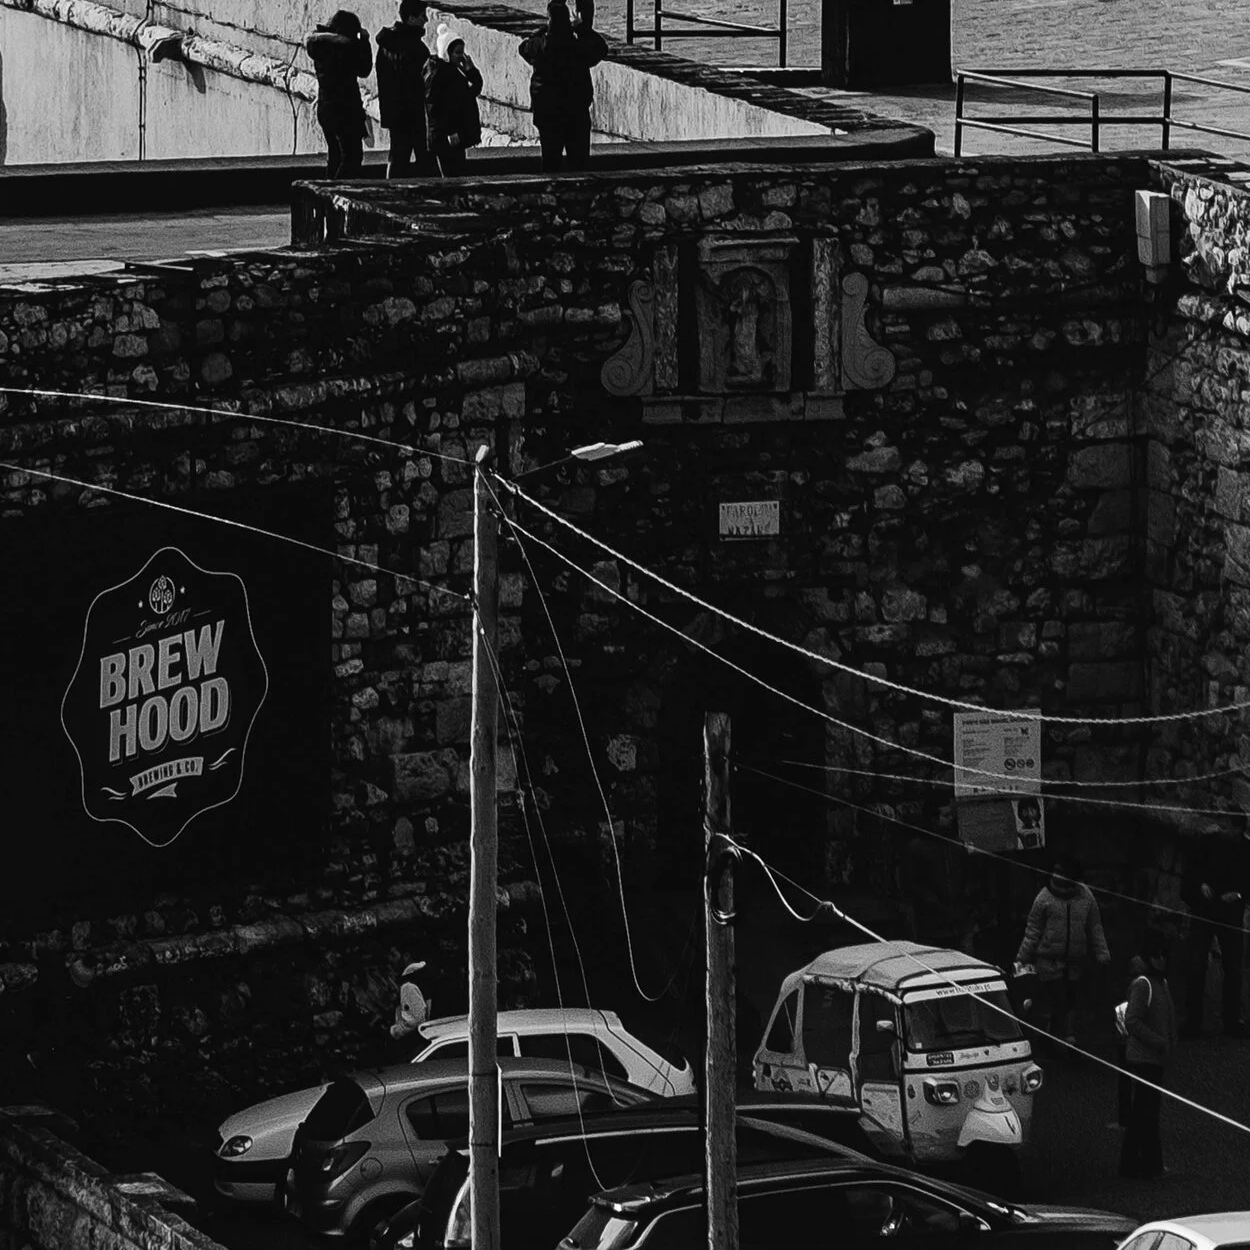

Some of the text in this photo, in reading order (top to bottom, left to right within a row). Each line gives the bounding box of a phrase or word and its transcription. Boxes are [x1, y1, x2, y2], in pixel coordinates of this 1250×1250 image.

[100, 619, 225, 709] BREW
[109, 677, 230, 764] HOOD
[138, 764, 174, 789] BREWING
